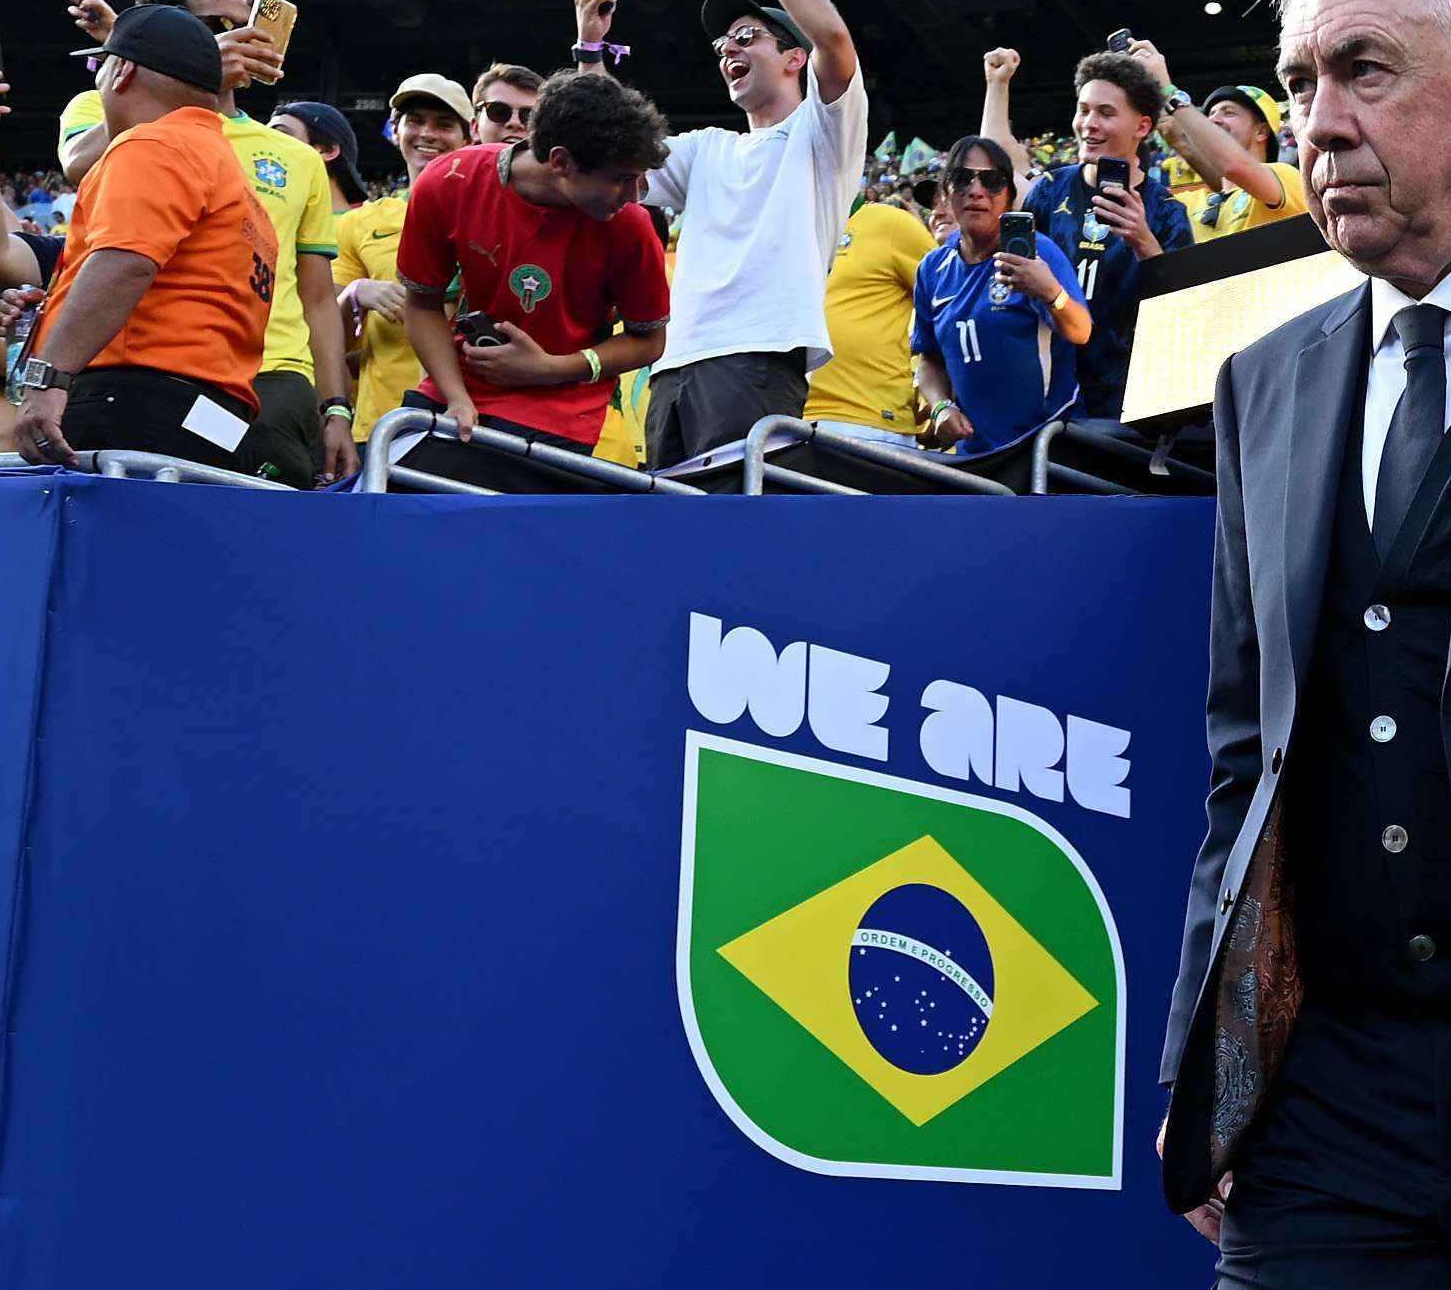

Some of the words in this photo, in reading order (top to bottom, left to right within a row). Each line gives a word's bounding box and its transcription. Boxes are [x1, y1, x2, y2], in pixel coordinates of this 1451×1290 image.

[687, 611, 891, 762] WE
[860, 931, 908, 952] ORDEM
[919, 947, 989, 1010] PROGRESSO
